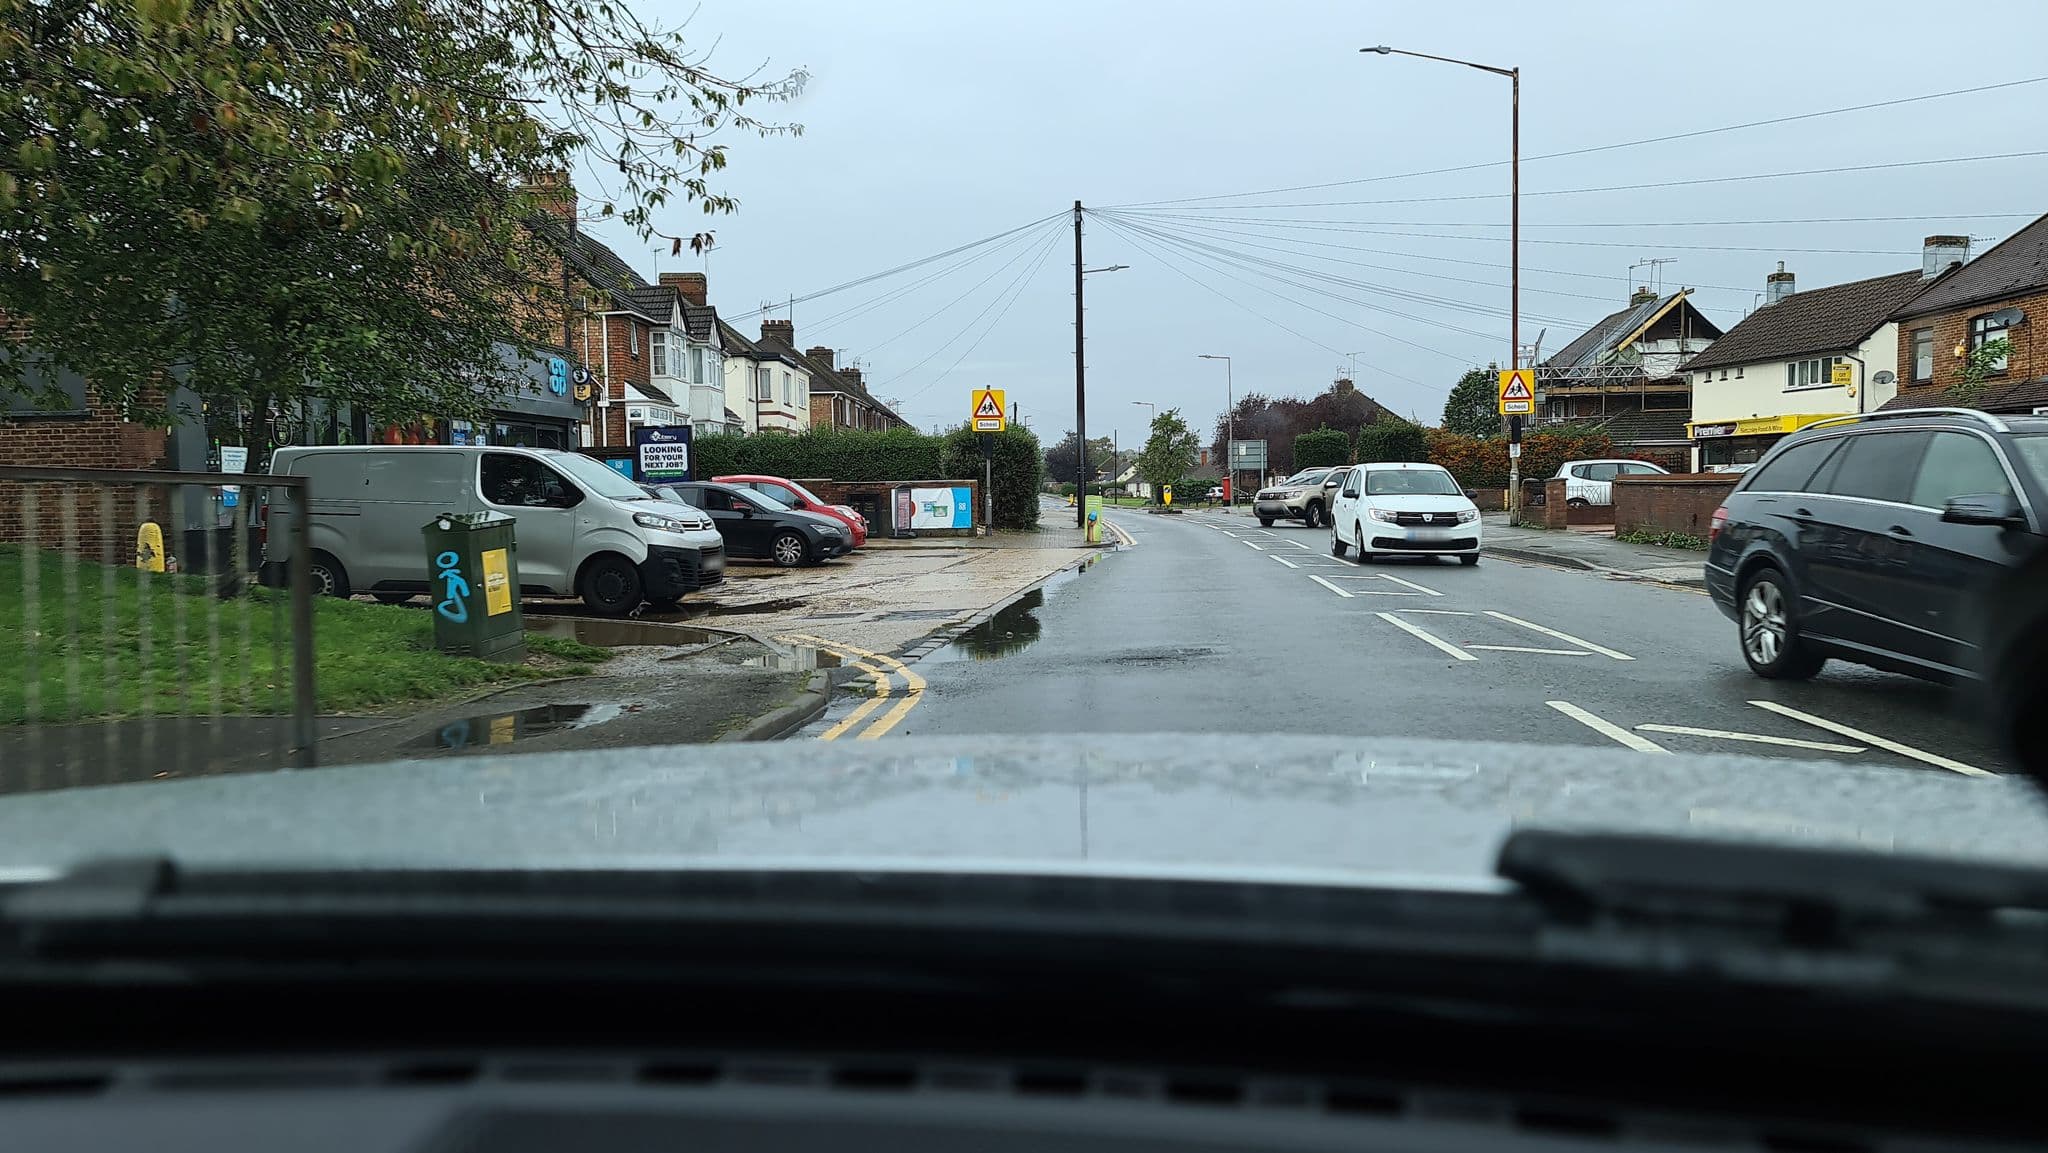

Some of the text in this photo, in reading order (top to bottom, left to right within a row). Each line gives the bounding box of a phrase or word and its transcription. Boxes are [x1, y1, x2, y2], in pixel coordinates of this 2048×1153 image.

[1694, 424, 1725, 437] Premier
[644, 446, 683, 454] LOOKING
[665, 461, 684, 469] JOB?
